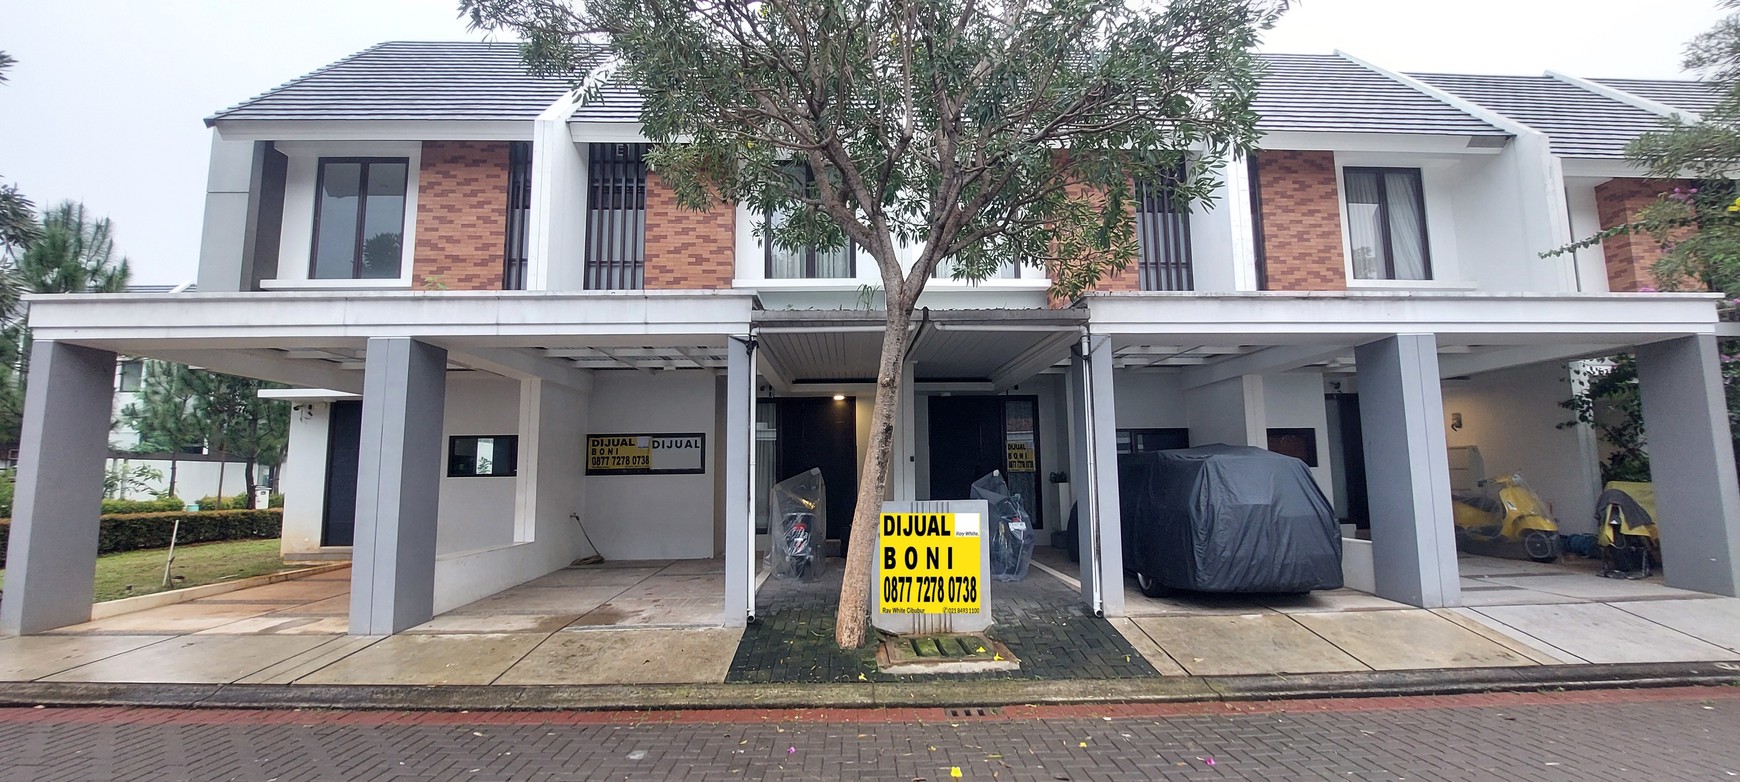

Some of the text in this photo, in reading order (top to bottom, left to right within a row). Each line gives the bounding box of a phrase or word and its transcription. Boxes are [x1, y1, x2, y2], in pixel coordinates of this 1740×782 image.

[592, 438, 635, 447] DIJUAL
[652, 439, 700, 449] DIJUAL
[591, 455, 650, 466] 0877 7278 0738
[884, 515, 951, 536] DIJUAL
[884, 546, 953, 570] BONI
[884, 576, 977, 603] 0877 7278 0738
